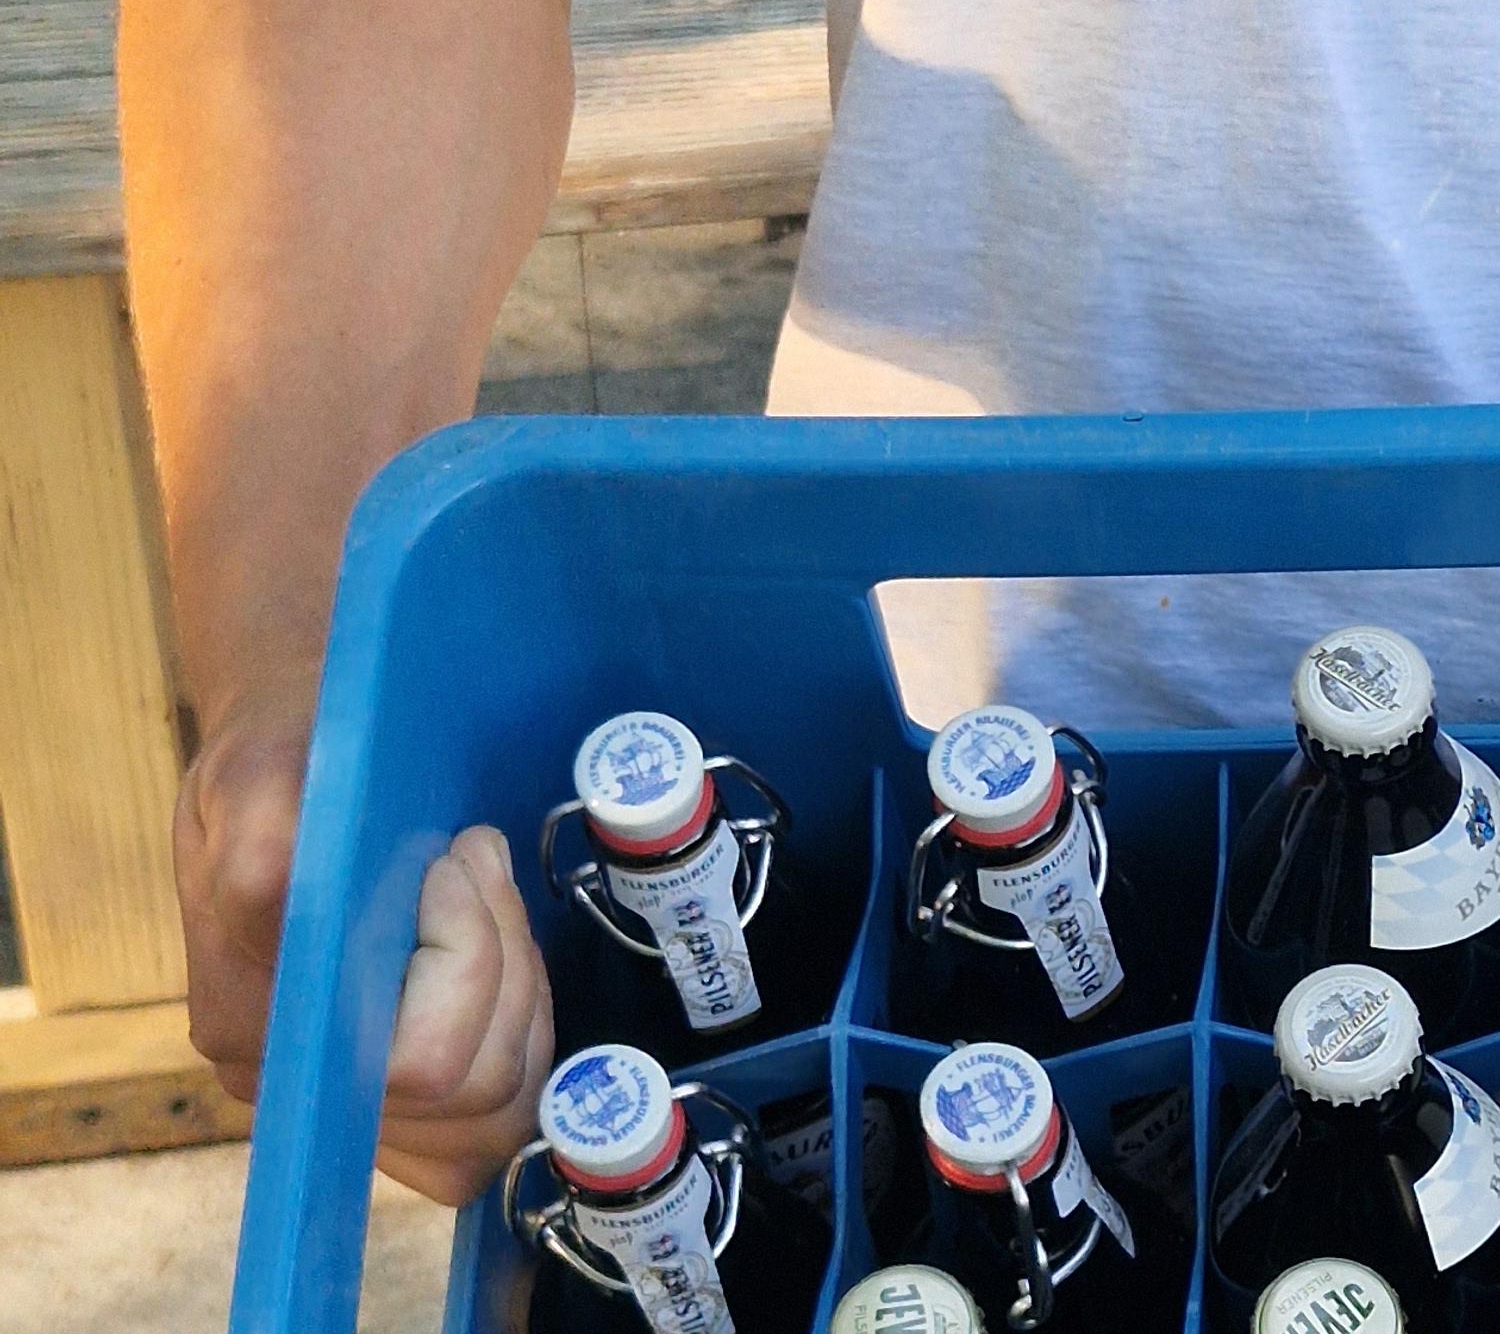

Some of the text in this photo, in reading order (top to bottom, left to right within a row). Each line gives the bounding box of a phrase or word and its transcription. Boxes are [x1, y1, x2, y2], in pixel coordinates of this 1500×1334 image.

[620, 843, 724, 892] FLENSBURGER
[687, 931, 734, 1016] PILSENER
[1056, 913, 1104, 999] PILSENER
[956, 1053, 1035, 1090] FLENSBURGER
